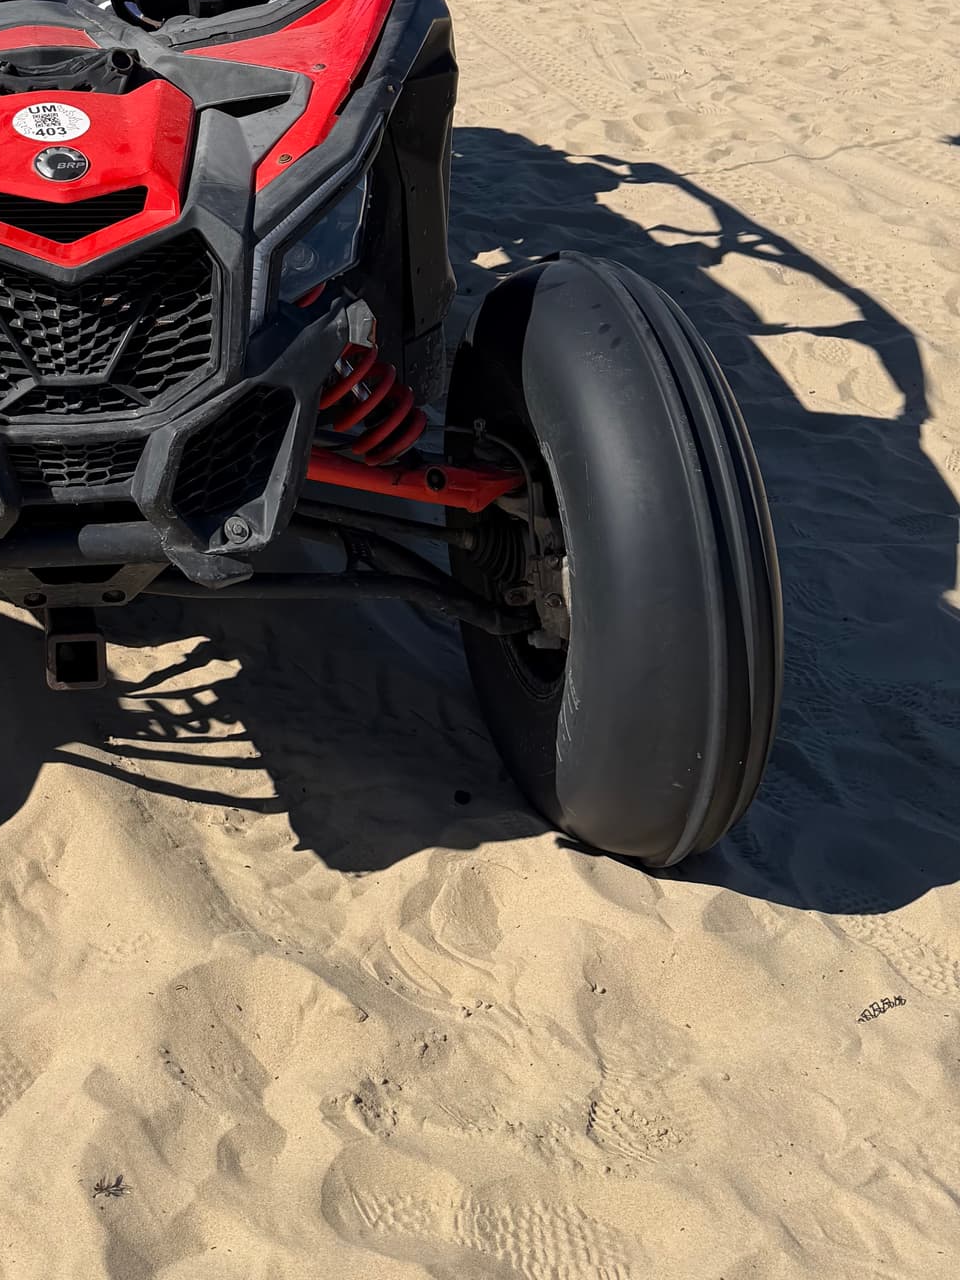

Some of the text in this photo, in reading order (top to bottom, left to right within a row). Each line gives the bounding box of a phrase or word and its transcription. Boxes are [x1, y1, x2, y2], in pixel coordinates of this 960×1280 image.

[28, 104, 57, 115] UM
[35, 126, 67, 137] 403
[57, 161, 86, 170] BRP
